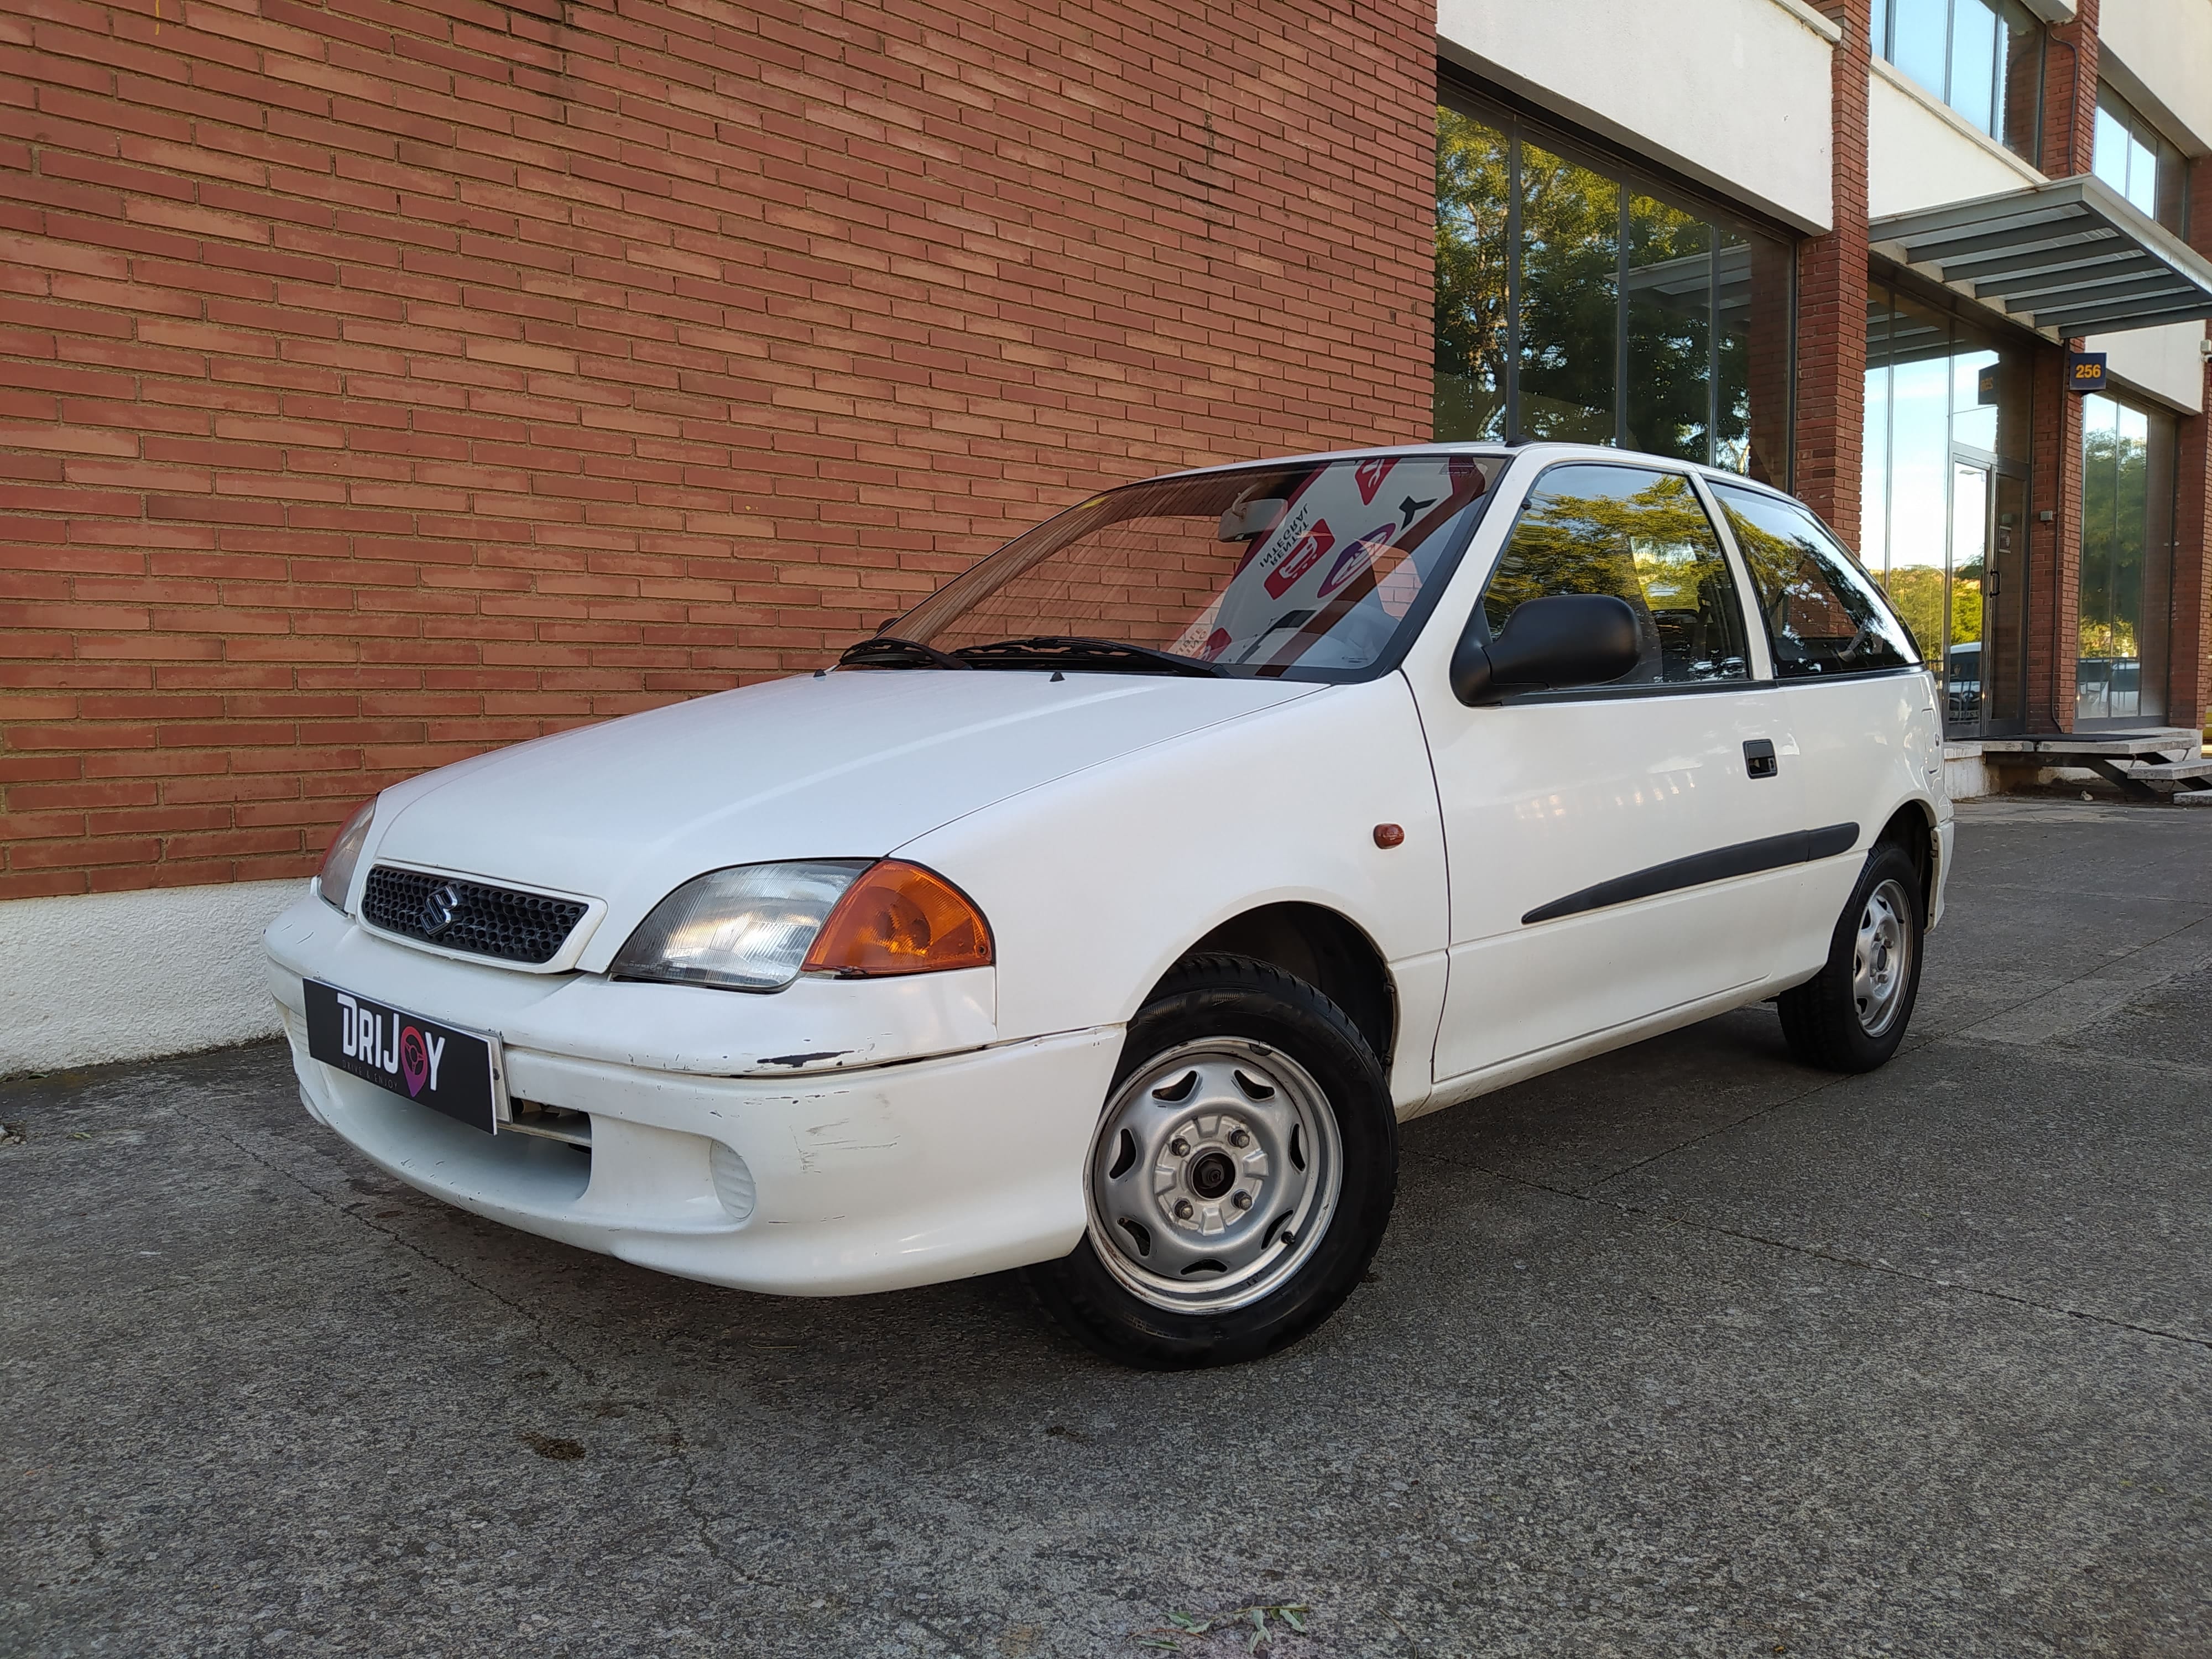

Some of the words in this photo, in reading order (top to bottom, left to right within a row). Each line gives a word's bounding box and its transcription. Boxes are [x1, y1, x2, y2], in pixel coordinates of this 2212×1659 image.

[2075, 364, 2101, 379] 256
[337, 992, 445, 1097] DRIJOY
[342, 1059, 362, 1076] DRIVE
[374, 1073, 398, 1089] ENJOY
